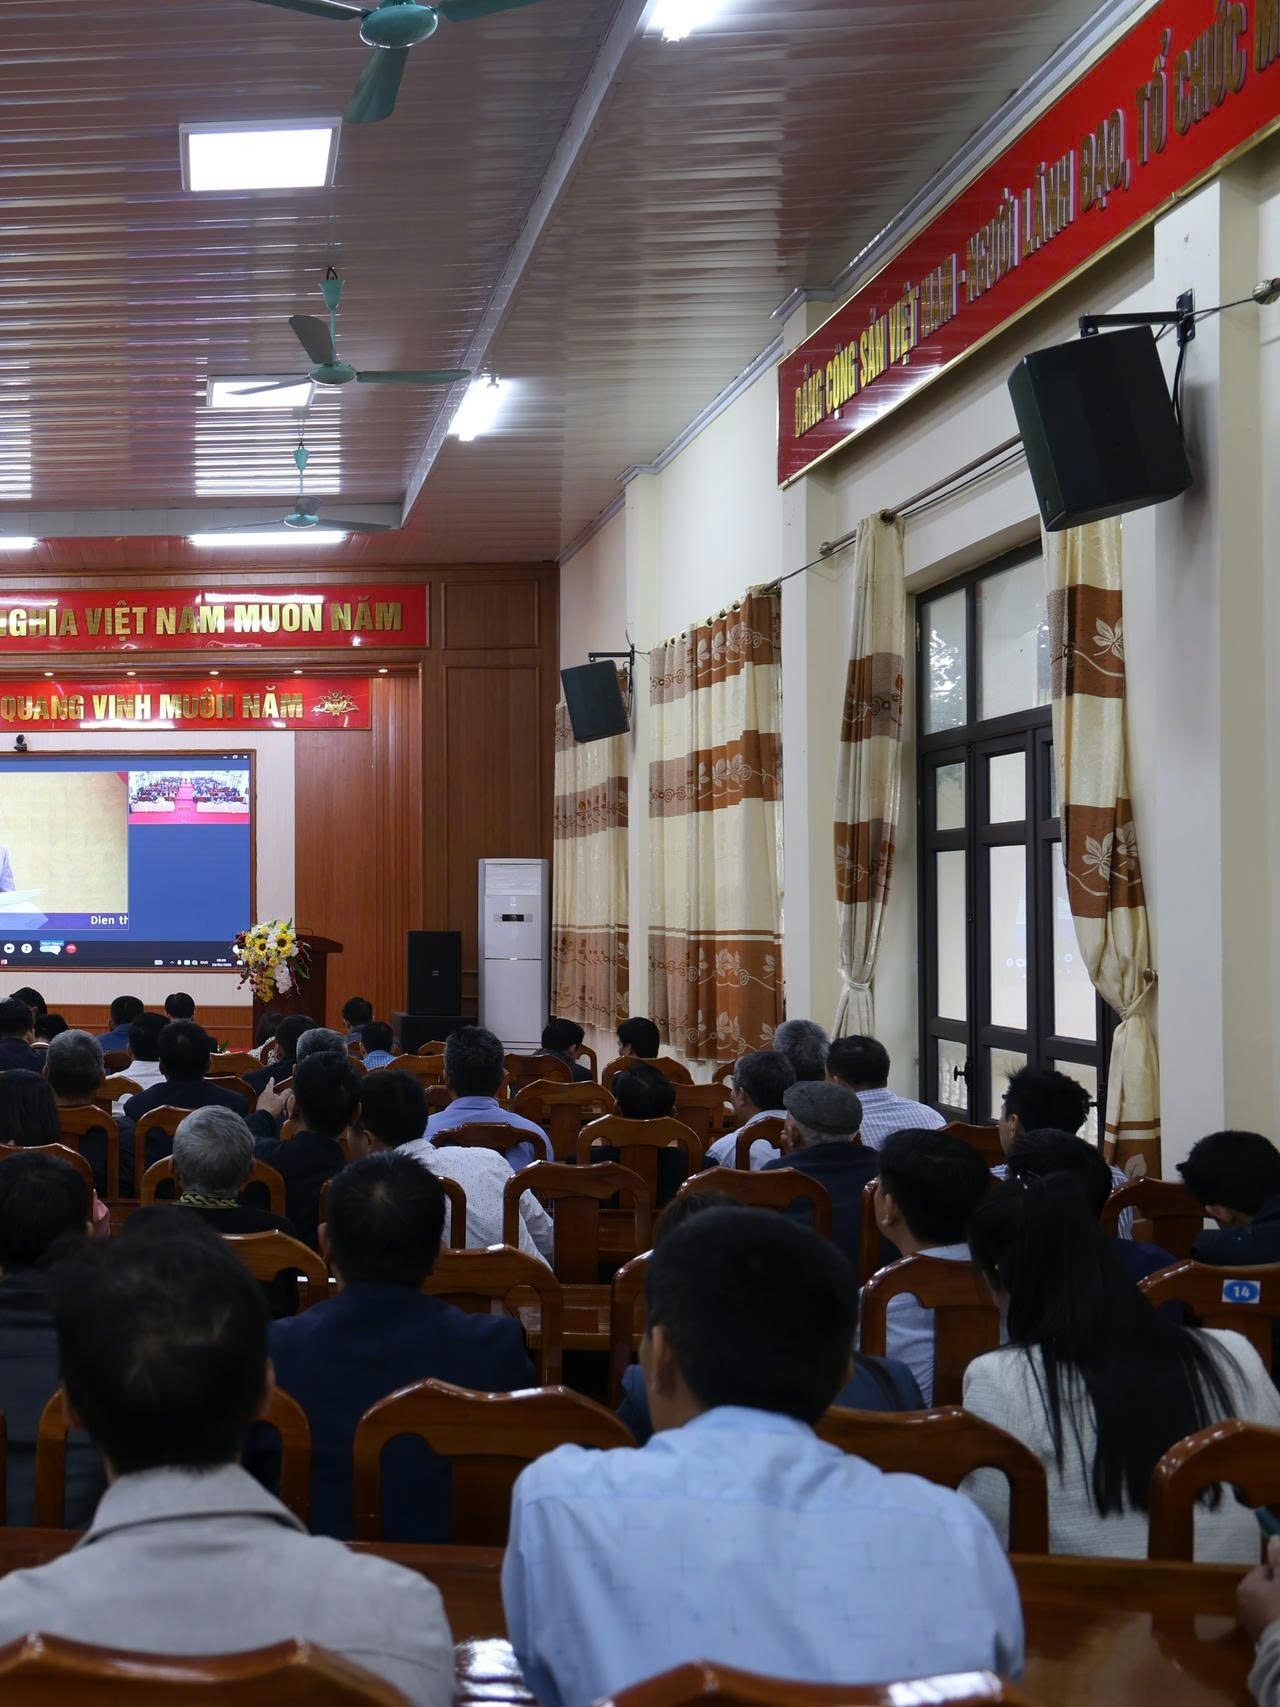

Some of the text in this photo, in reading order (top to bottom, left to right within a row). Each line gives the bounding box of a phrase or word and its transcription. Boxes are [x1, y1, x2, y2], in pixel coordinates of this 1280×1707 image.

[826, 340, 859, 420] CỘNG
[860, 307, 888, 388] SẢN
[889, 281, 920, 366] VIỆT
[85, 600, 148, 642] VIỆT
[156, 605, 226, 635] NAM
[330, 595, 402, 632] NĂM
[0, 695, 85, 722] QUANG
[92, 694, 151, 721] VINH
[159, 687, 234, 720] MUÔN
[242, 684, 303, 719] NĂM
[90, 915, 115, 925] Dien
[1232, 1286, 1251, 1298] 14
